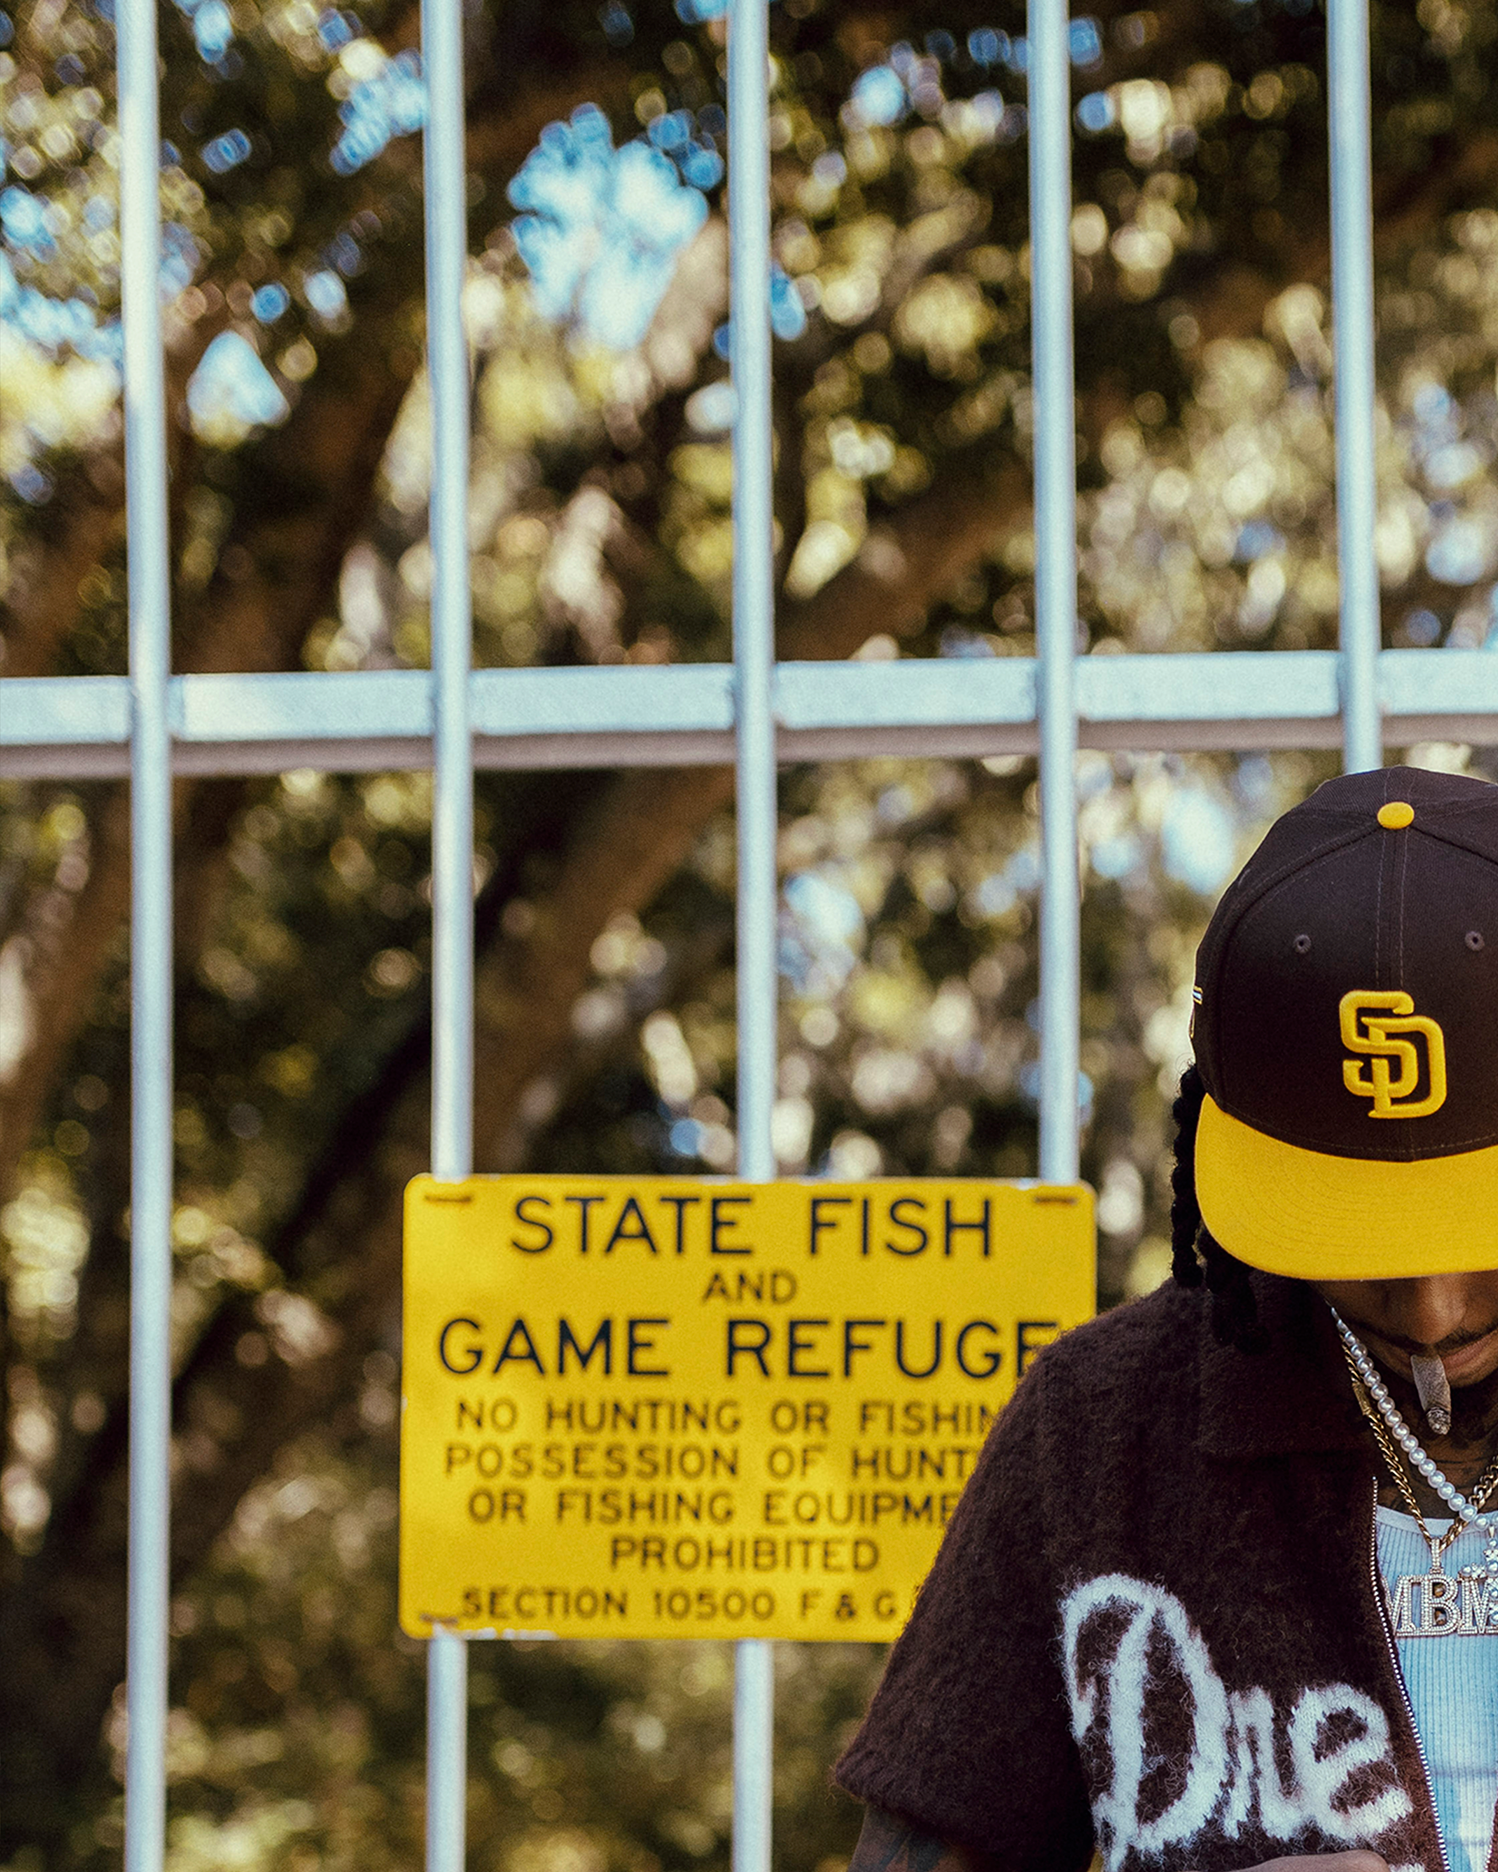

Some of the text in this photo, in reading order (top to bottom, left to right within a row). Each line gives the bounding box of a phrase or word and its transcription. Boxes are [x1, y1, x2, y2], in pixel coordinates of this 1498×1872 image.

[1339, 989, 1448, 1119] SD
[511, 1194, 993, 1260] STATE FISH
[701, 1269, 798, 1306] AND
[437, 1316, 671, 1379] GAME
[456, 1397, 998, 1436] NO HUNTING OR FISHIN
[445, 1441, 977, 1483] POSSESSION OF HUNT
[467, 1487, 960, 1528] OR FISHING EQUIPME
[608, 1532, 882, 1575] PROHIBITED
[460, 1586, 898, 1622] SECTION 10500 F & G
